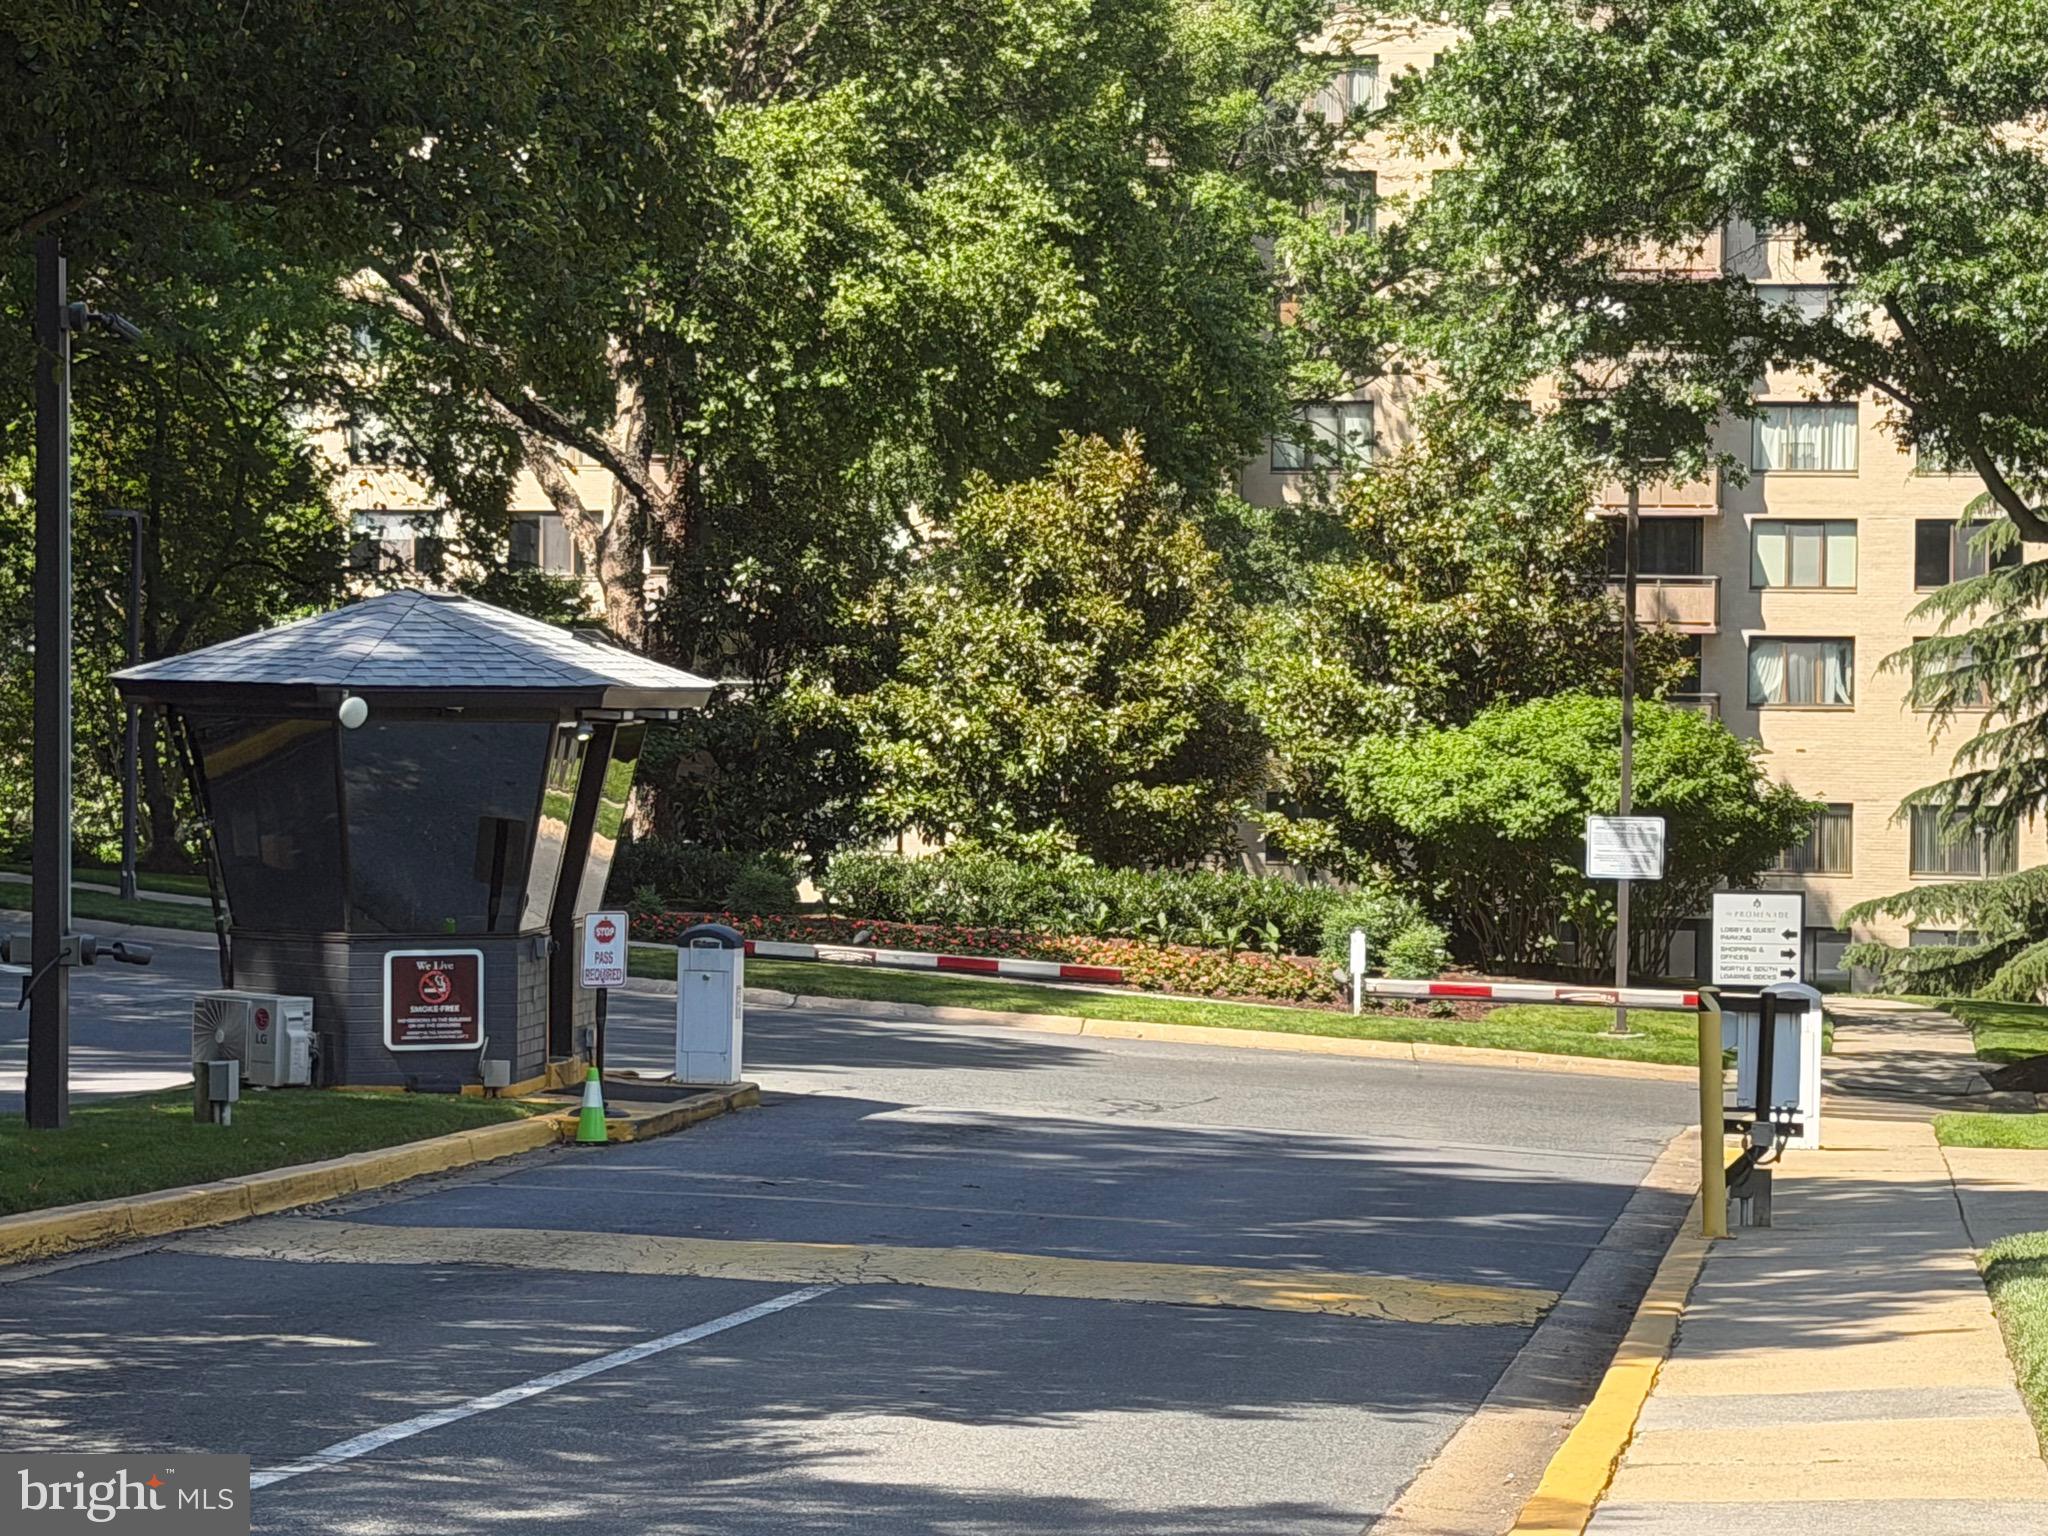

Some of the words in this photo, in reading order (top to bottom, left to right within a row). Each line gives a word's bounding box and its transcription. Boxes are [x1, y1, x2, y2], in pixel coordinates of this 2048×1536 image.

[1734, 910, 1790, 919] PROMENADE
[596, 927, 614, 937] STOP
[594, 951, 613, 964] PASS
[416, 961, 431, 970] We
[434, 961, 454, 970] Live
[585, 968, 622, 981] REQUIRED
[410, 1005, 460, 1013] SMOKE-FREE
[256, 1034, 267, 1044] LG
